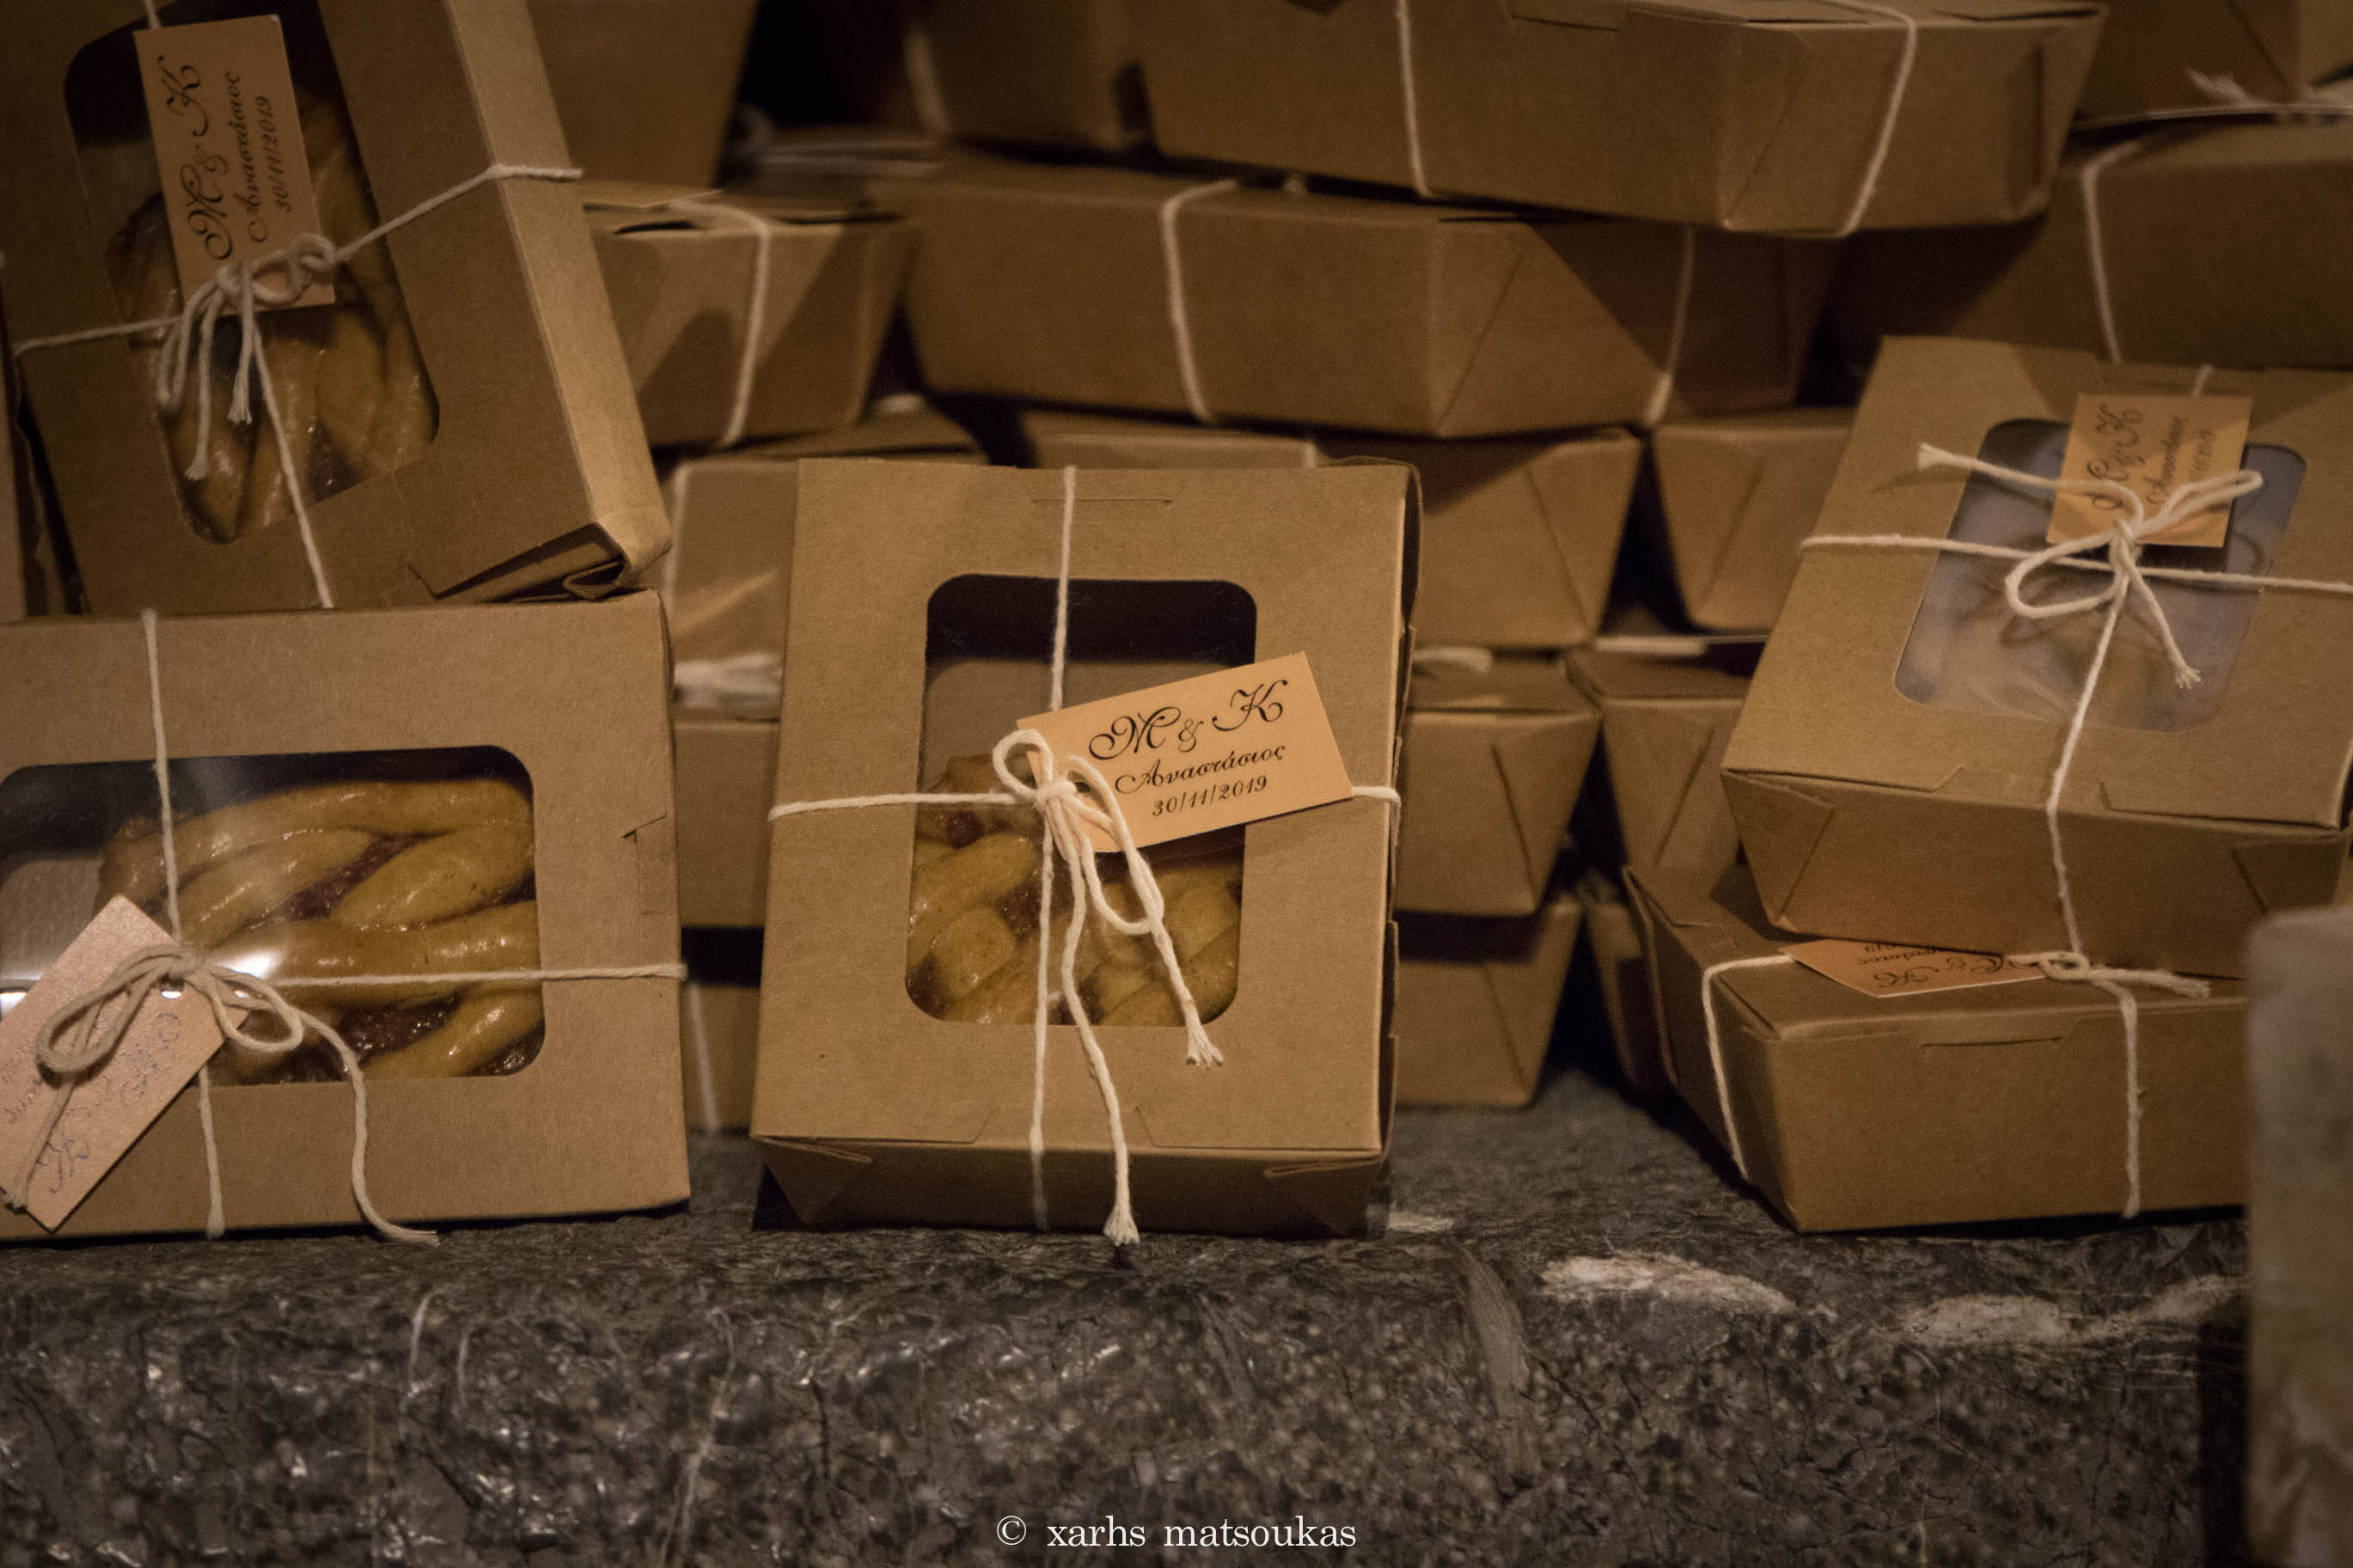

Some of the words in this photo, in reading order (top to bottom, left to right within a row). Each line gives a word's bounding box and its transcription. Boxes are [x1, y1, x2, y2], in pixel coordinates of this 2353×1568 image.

[157, 55, 208, 137] K
[255, 95, 290, 214] 30/11/2019
[1089, 706, 1182, 760] M
[1177, 718, 1205, 753] &
[1212, 679, 1288, 732] K
[1115, 742, 1287, 795] Αναστάσιος
[1152, 775, 1268, 818] 30/11/2019
